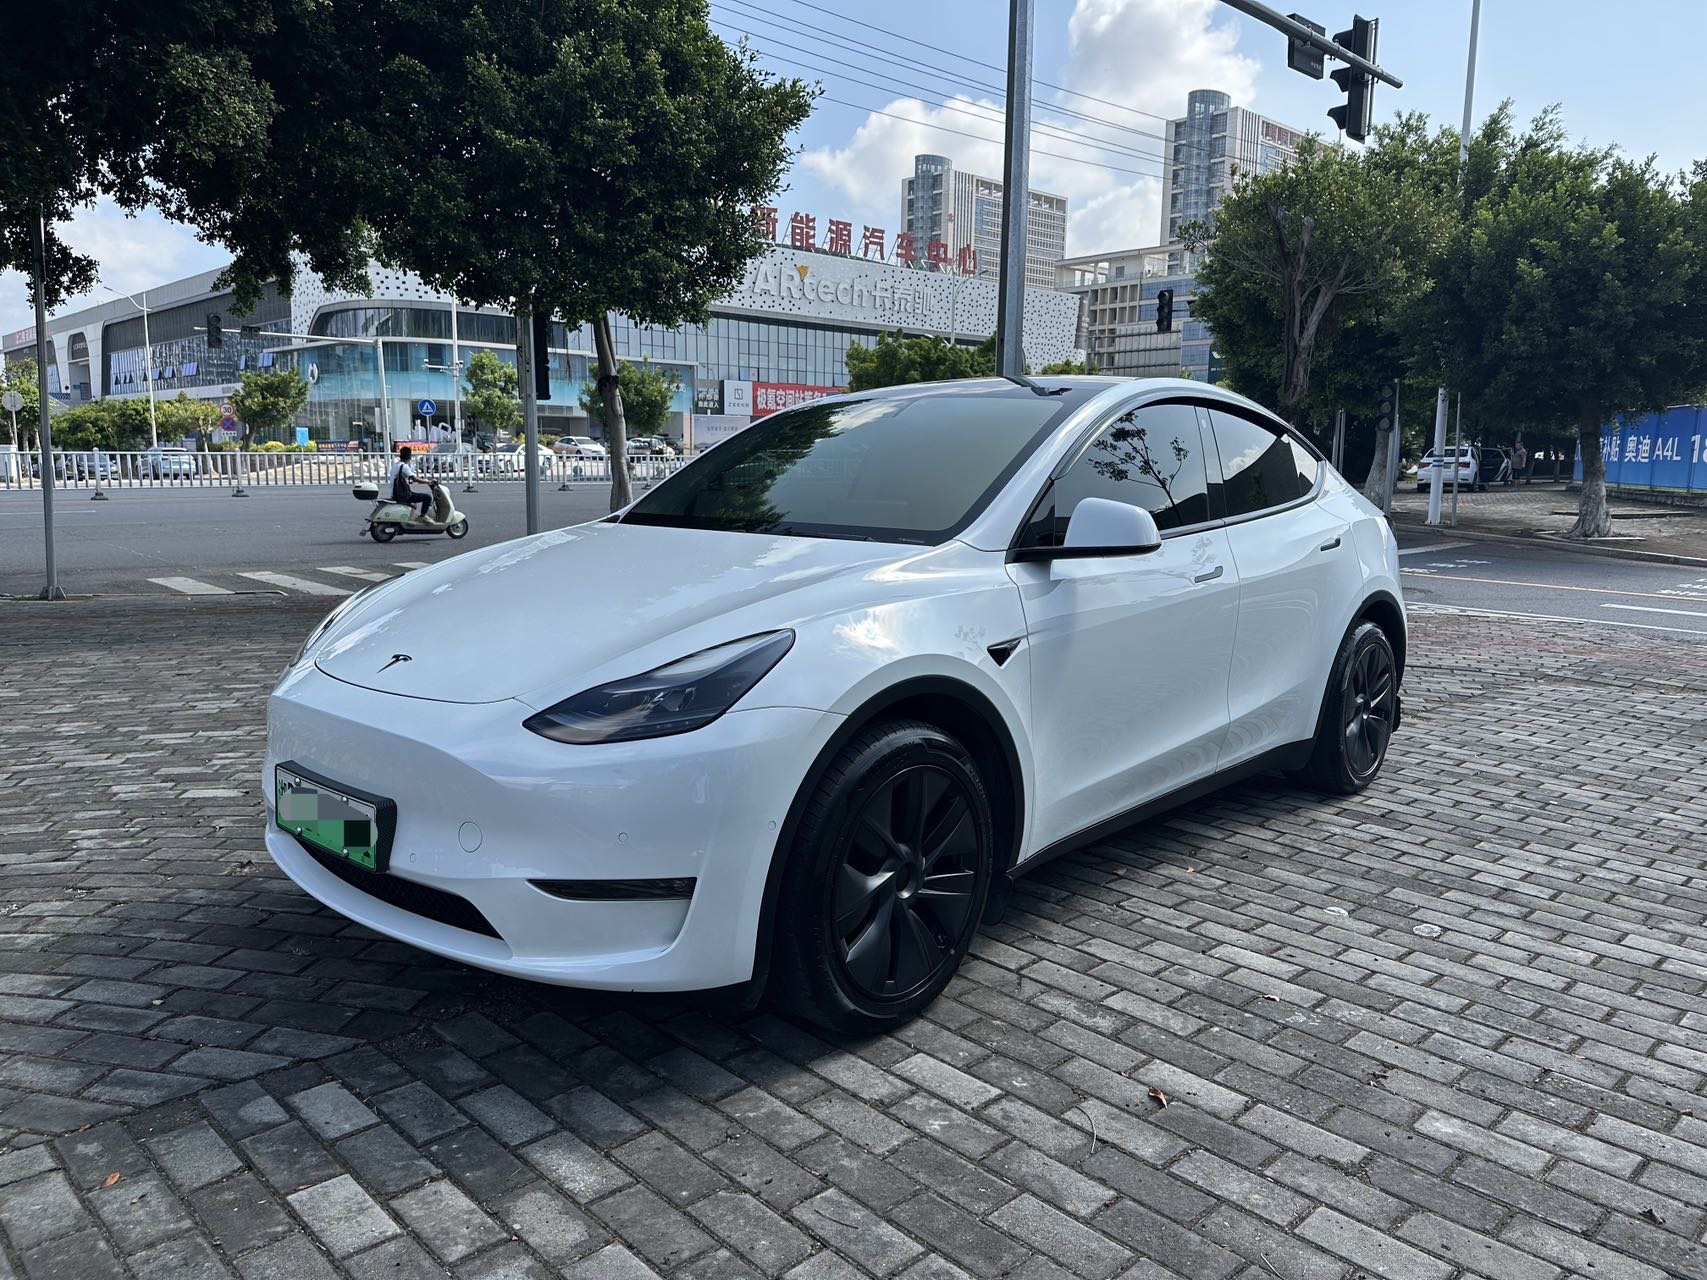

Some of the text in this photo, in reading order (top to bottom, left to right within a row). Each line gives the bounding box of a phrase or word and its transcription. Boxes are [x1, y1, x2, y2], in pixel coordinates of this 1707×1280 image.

[756, 207, 978, 276] 新能源汽车中心
[738, 264, 866, 308] ARtech
[1624, 434, 1651, 463] 奥迪
[1653, 436, 1682, 461] A4L
